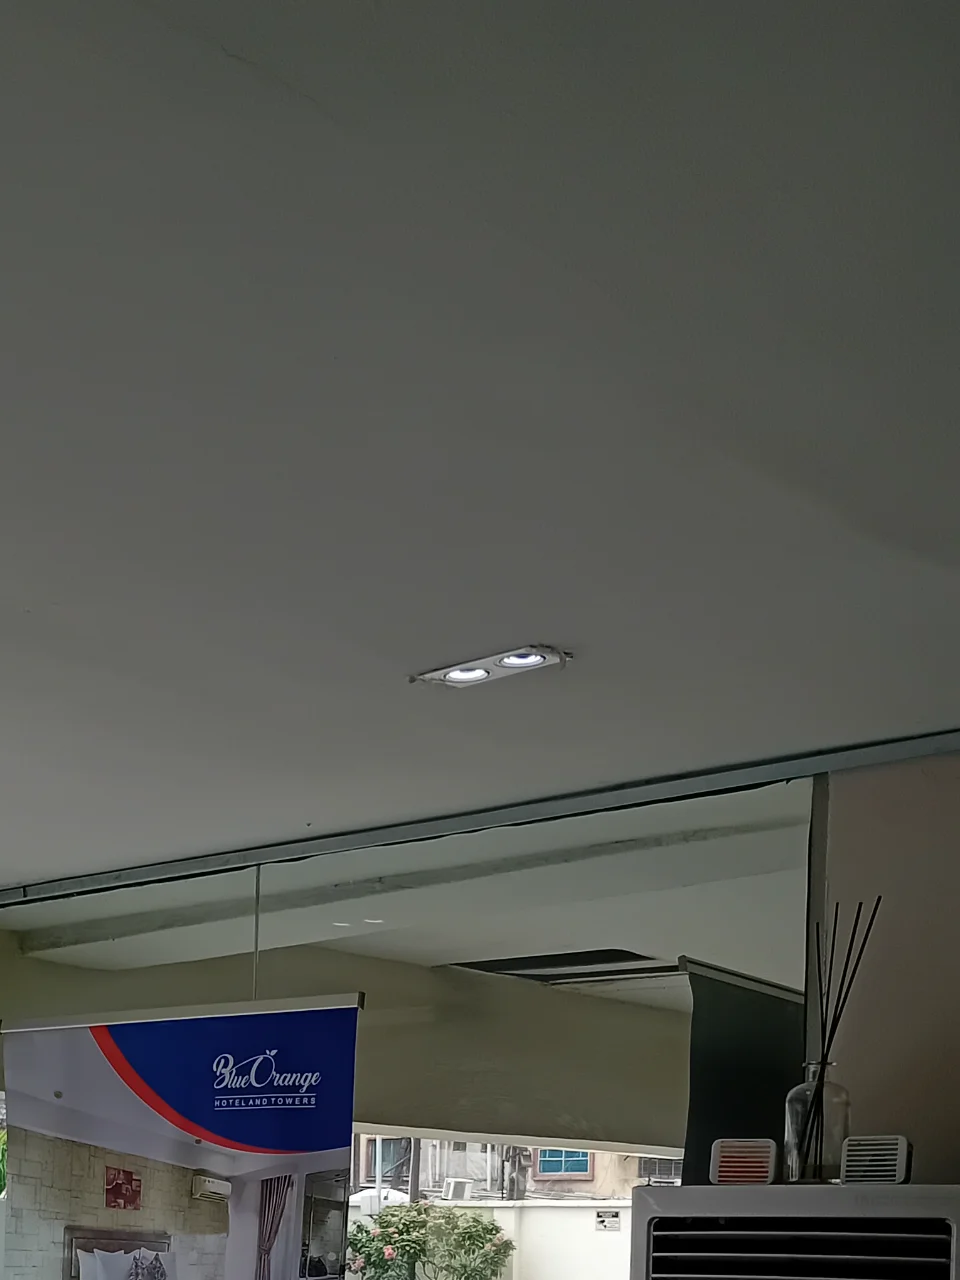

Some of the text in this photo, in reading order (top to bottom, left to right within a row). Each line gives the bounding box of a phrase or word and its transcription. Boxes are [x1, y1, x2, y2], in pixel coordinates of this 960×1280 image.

[212, 1053, 322, 1093] Blue Orange
[270, 1096, 317, 1105] TOWERS
